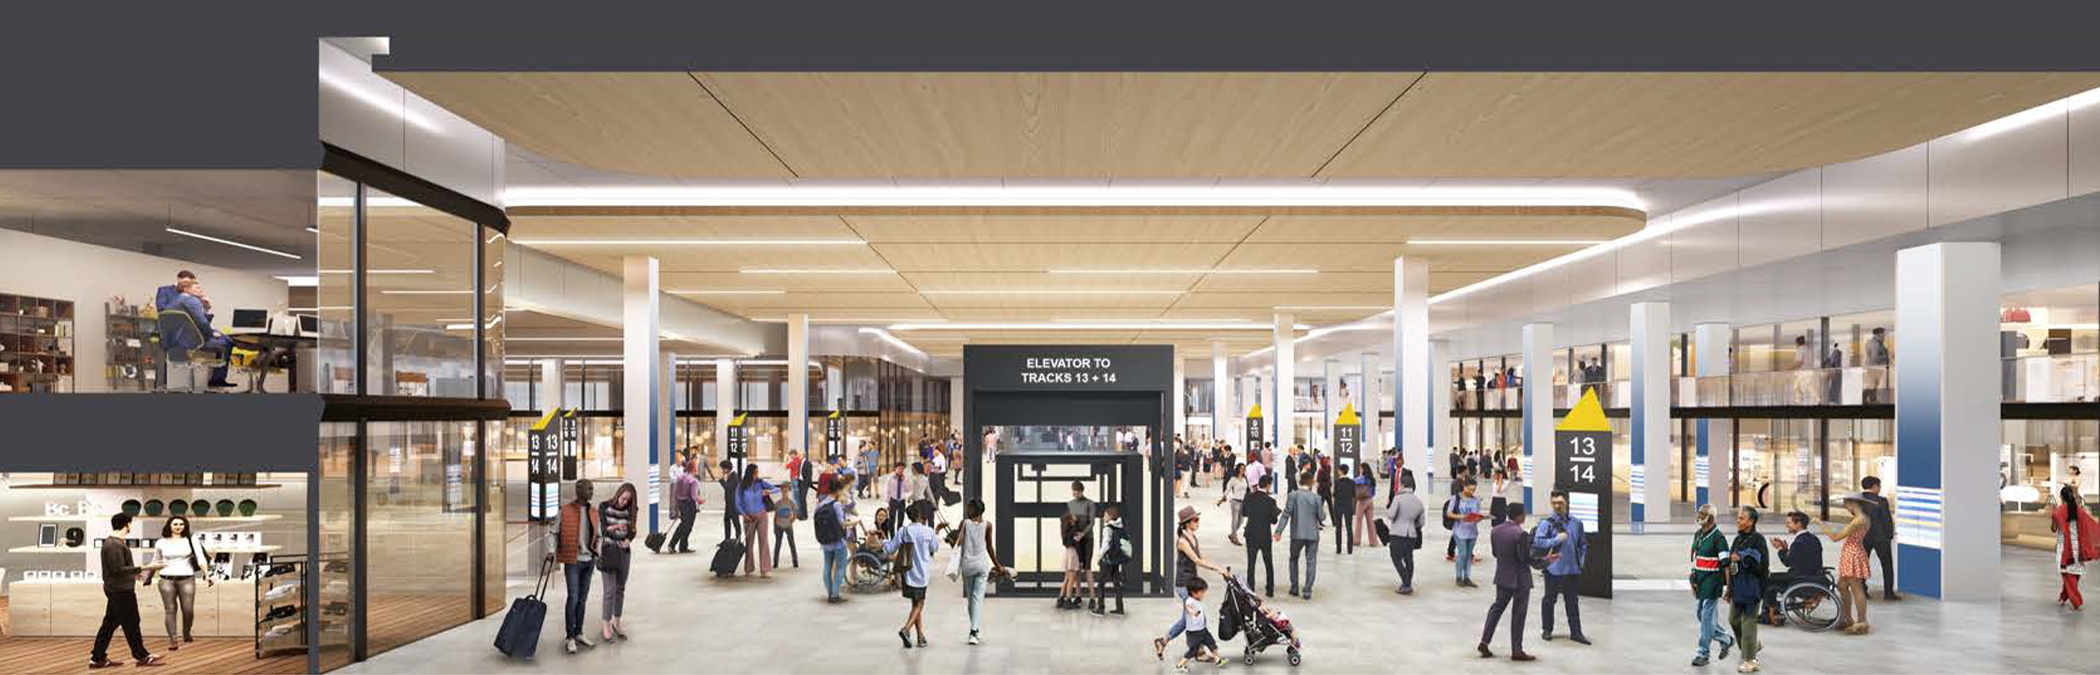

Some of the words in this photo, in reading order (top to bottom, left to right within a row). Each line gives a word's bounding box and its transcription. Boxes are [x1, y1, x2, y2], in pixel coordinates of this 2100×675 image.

[1026, 358, 1091, 369] ELEVATOR
[1094, 358, 1111, 369] TO
[1021, 372, 1072, 383] TRACKS
[1075, 372, 1089, 383] 13
[1102, 372, 1117, 383] 14
[1341, 427, 1352, 438] 11
[531, 434, 539, 450] 13
[546, 434, 558, 450] 13
[730, 442, 738, 453] 12
[1341, 442, 1353, 453] 12
[1570, 437, 1595, 455] 13
[546, 458, 558, 474] 14
[1570, 464, 1596, 483] 14
[66, 527, 84, 548] 9
